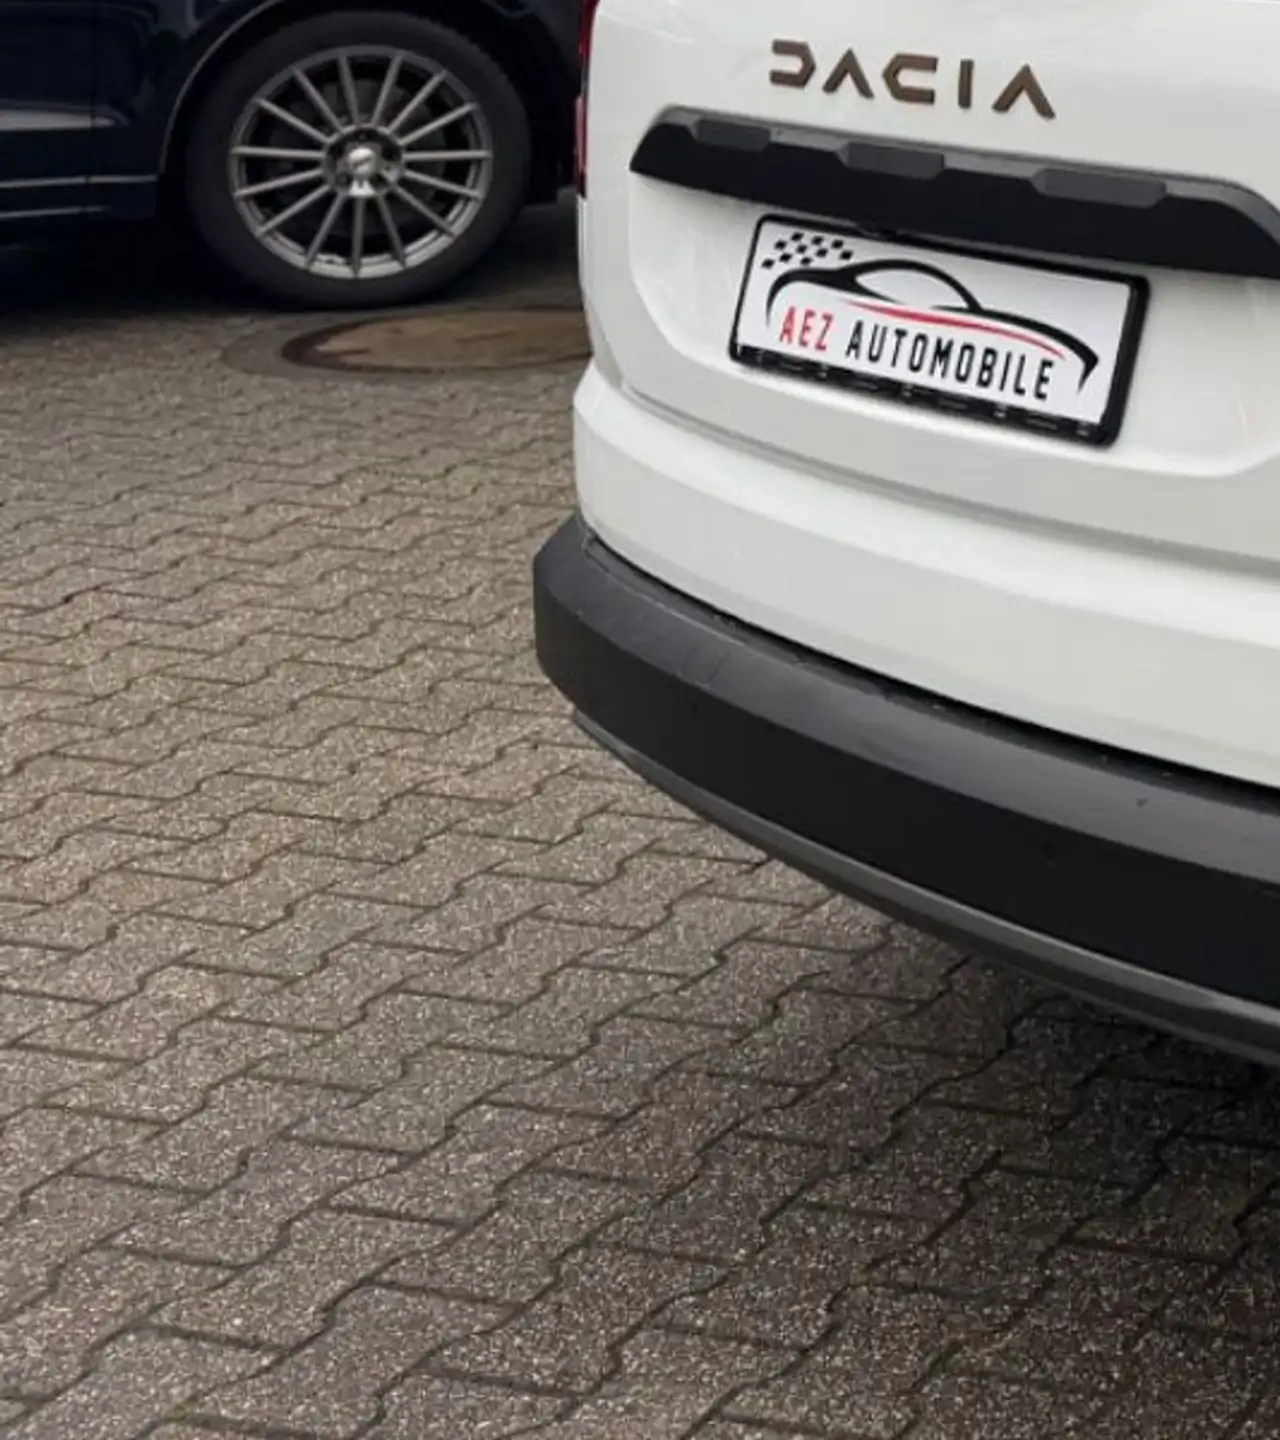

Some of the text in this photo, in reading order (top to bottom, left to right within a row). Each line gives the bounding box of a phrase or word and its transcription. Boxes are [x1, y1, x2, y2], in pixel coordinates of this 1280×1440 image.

[769, 38, 1056, 120] DACIA
[779, 306, 1054, 401] AEZ AUTOMOBILE
